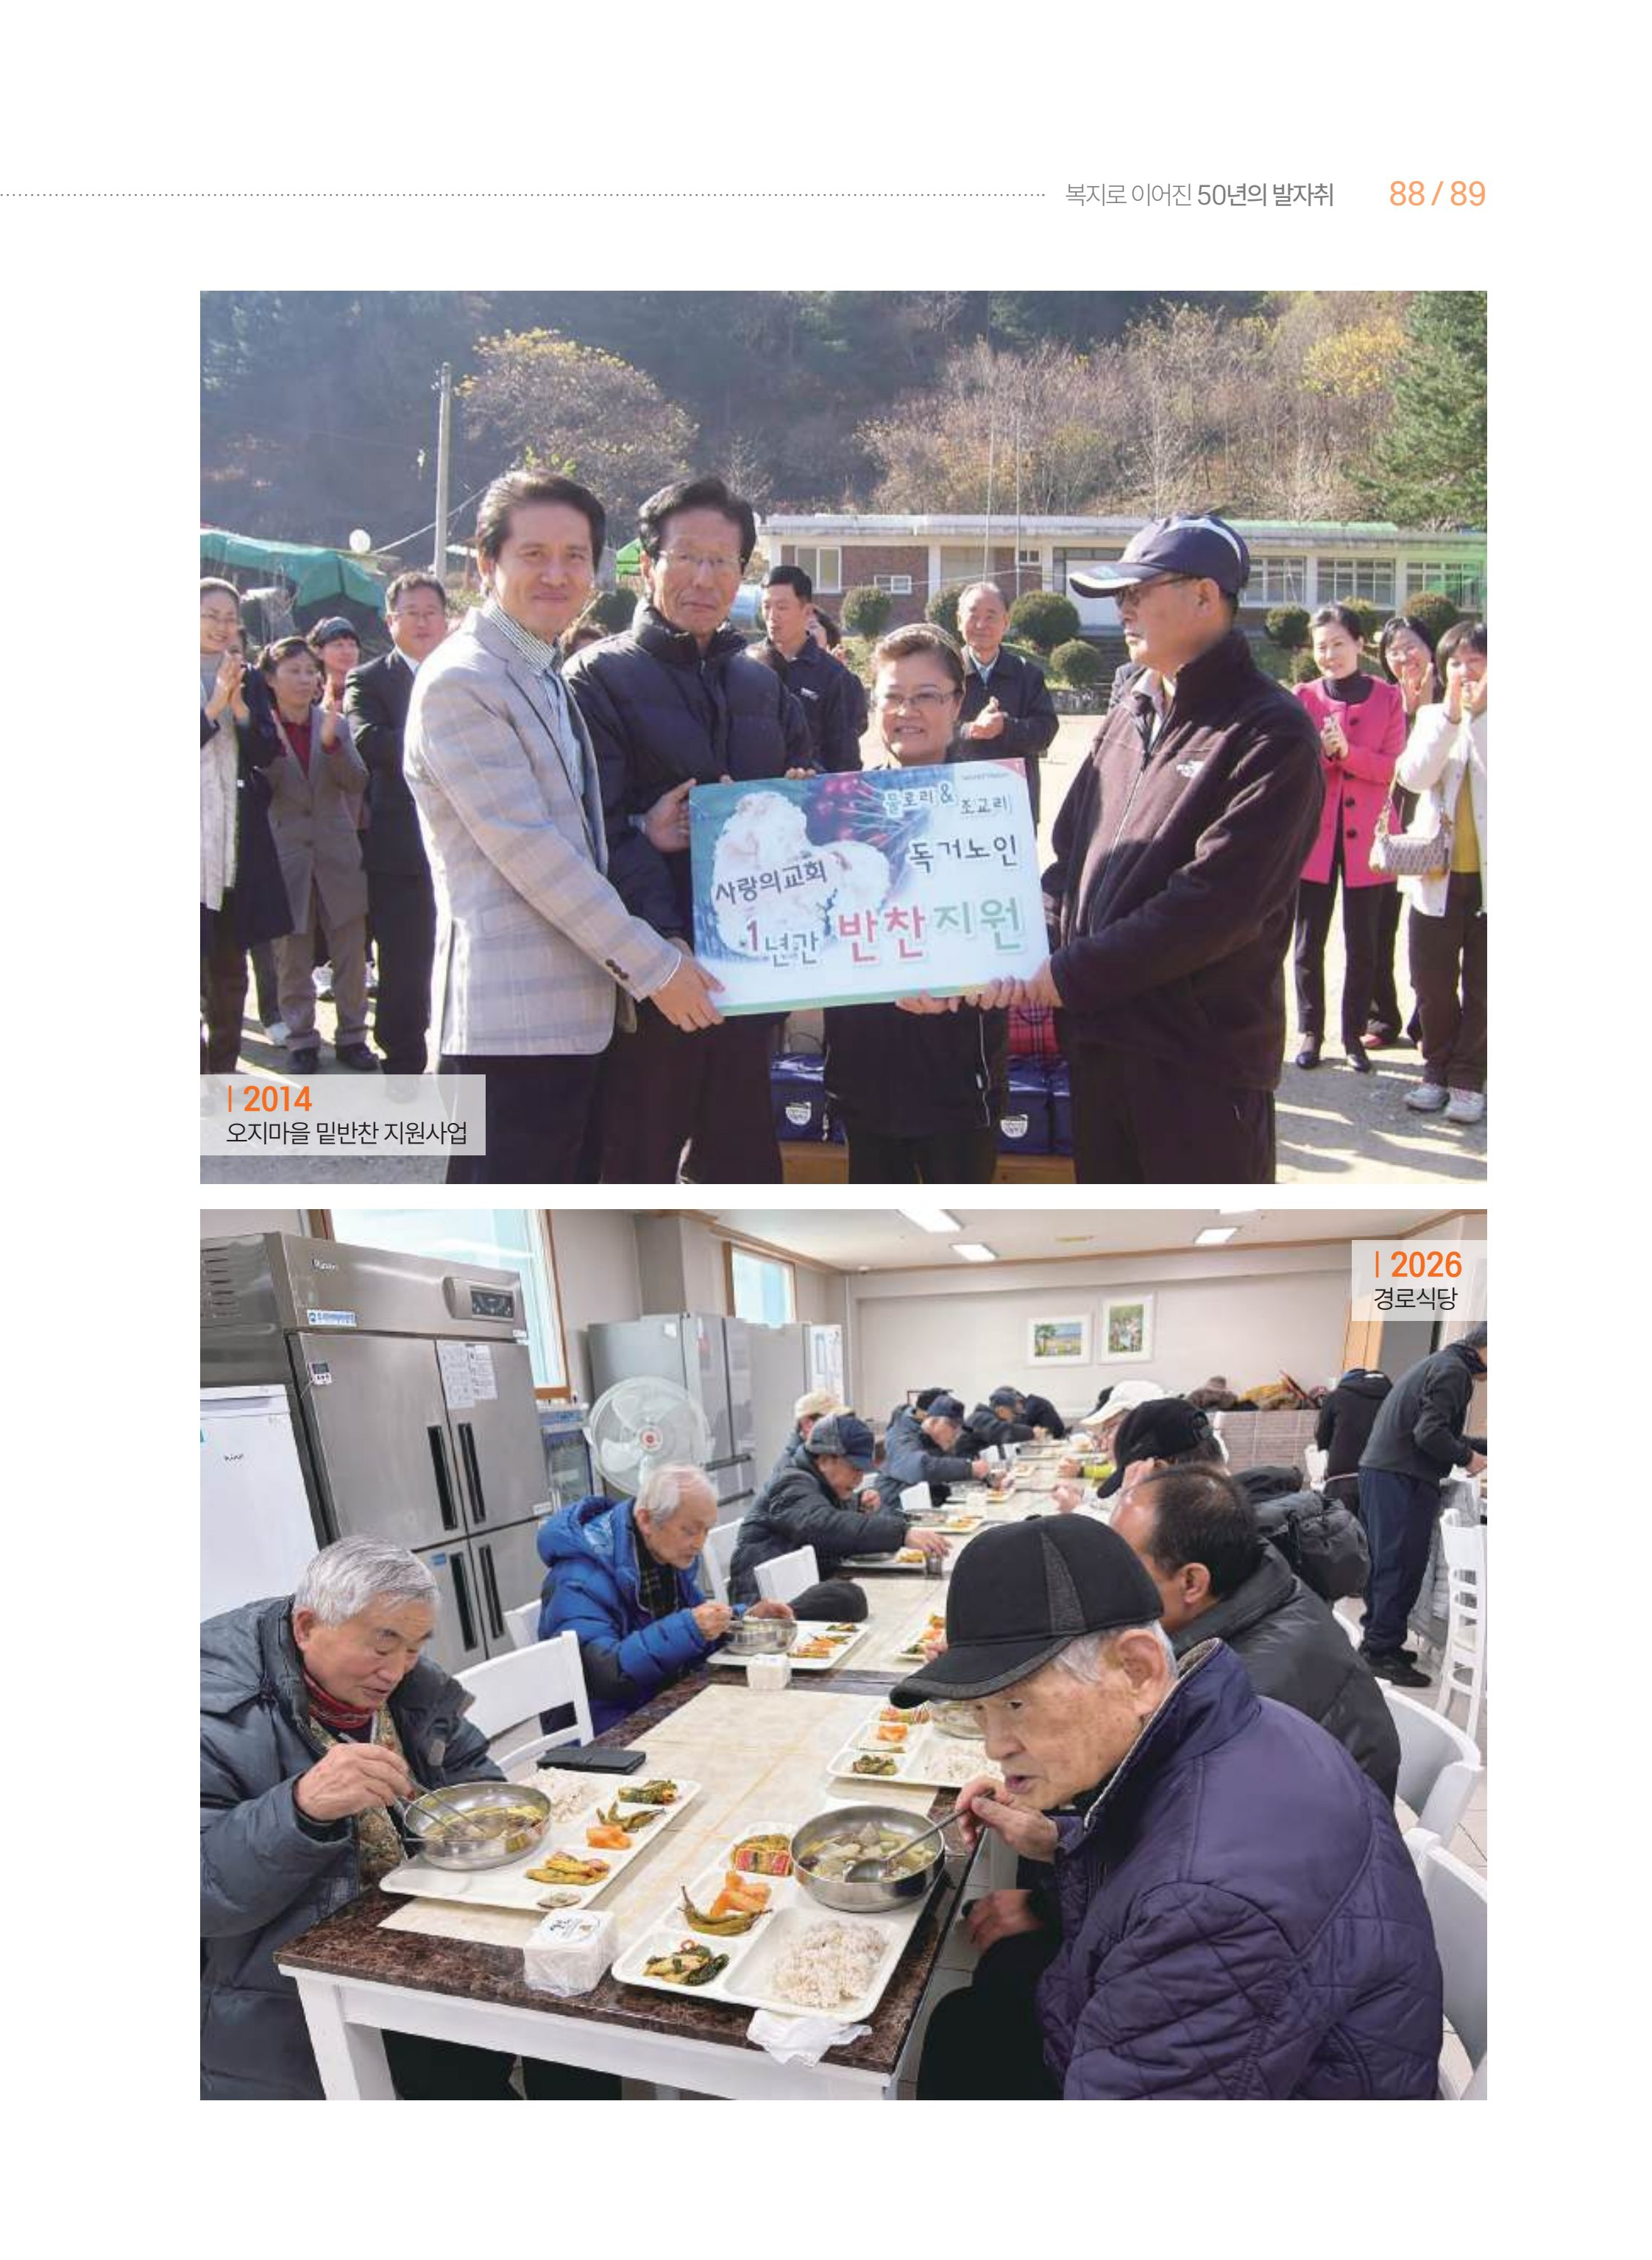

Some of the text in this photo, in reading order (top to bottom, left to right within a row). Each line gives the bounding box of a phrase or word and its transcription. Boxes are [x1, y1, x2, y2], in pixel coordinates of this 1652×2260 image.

[940, 782, 954, 804] &
[909, 834, 1018, 874] 독거노인
[715, 858, 827, 905] 사랑의교회
